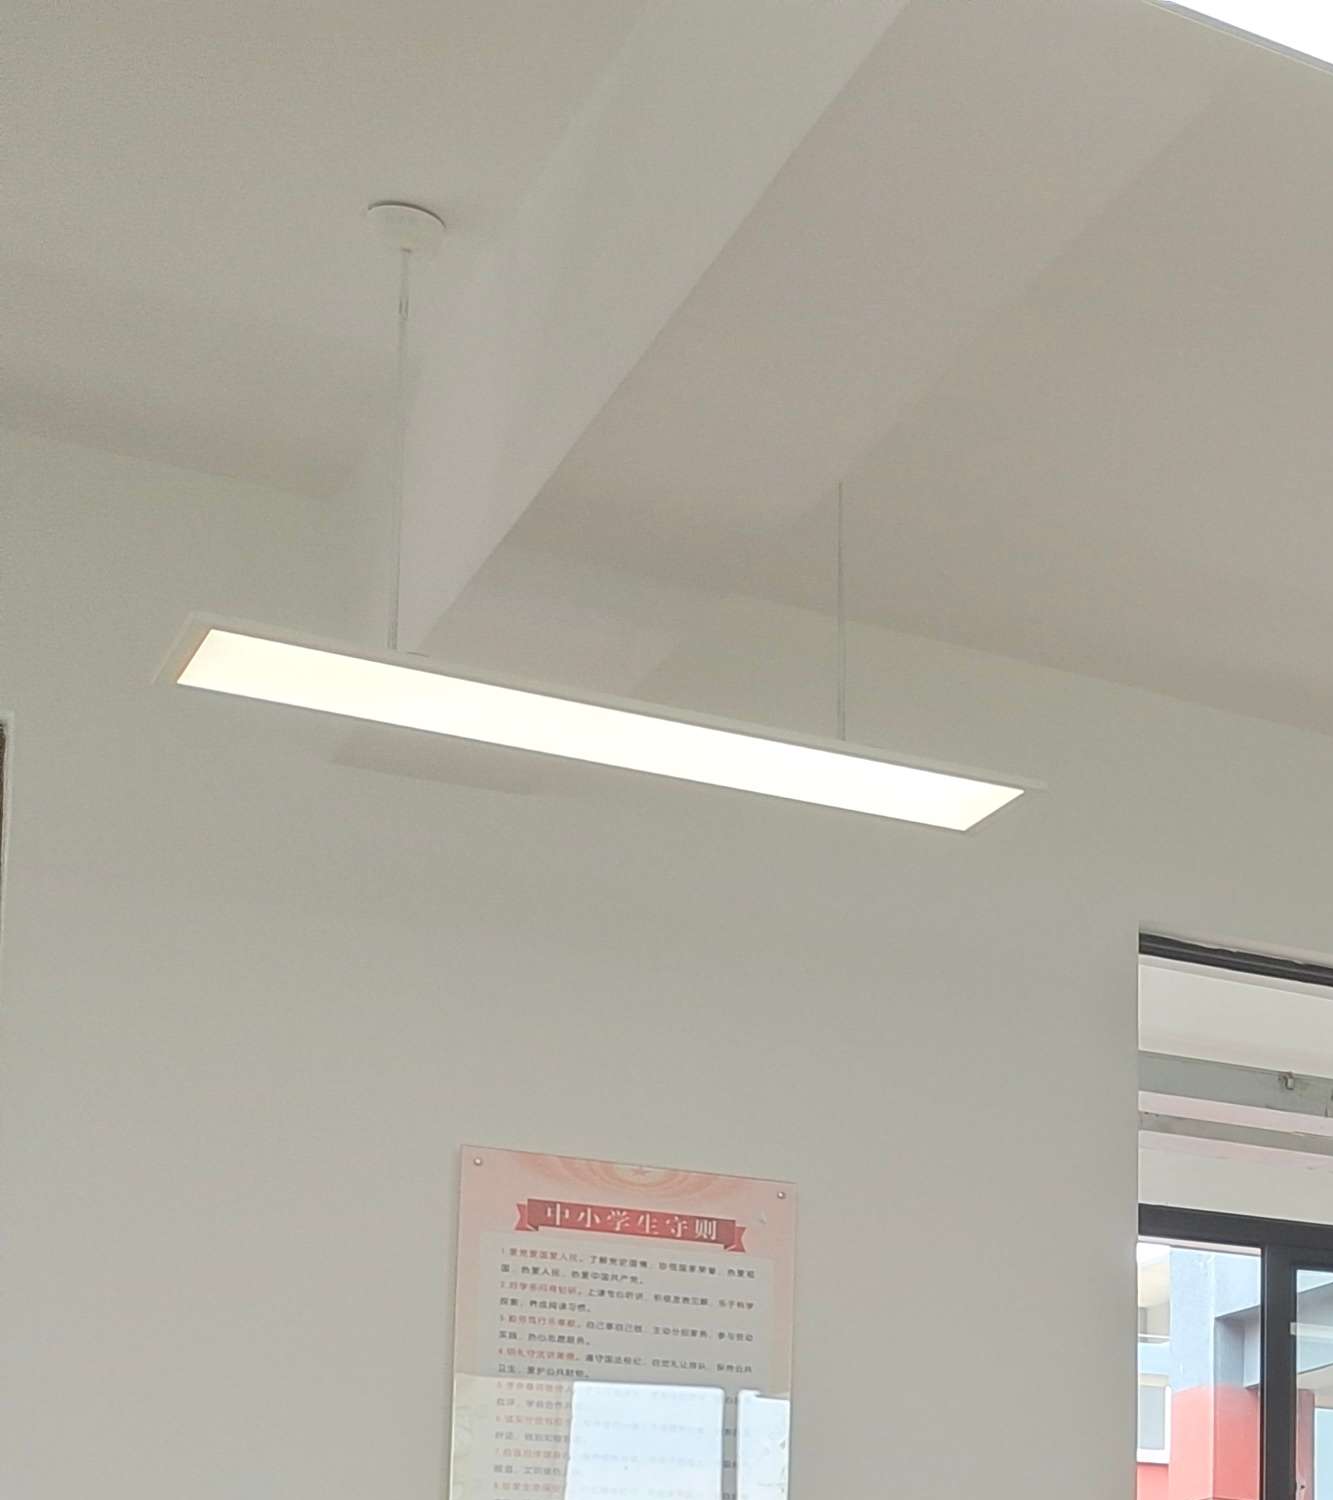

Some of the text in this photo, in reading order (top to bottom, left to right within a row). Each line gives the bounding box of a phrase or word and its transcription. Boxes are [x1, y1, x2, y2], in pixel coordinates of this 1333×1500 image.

[546, 1203, 718, 1240] 中小学生守则
